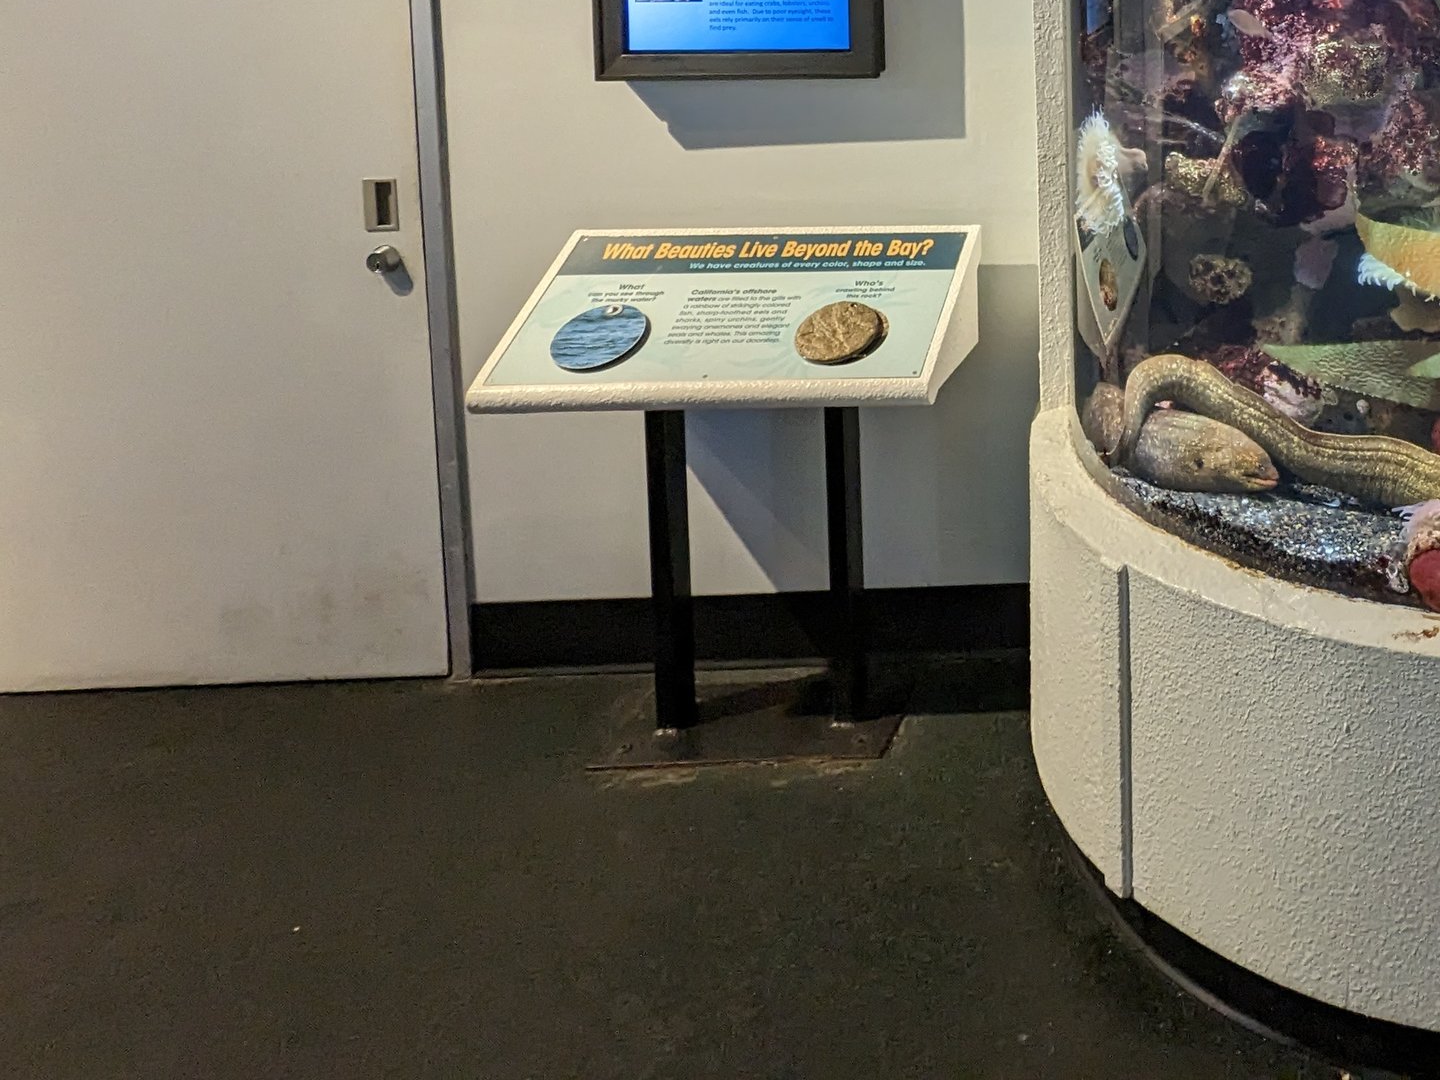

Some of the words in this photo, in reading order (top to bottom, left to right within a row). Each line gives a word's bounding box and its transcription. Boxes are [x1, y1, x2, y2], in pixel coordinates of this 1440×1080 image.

[603, 243, 654, 260] What
[654, 242, 736, 259] Beauties
[738, 241, 778, 258] Live
[781, 240, 852, 260] Beyond
[853, 240, 883, 256] the
[887, 239, 934, 259] Bay?
[852, 260, 882, 268] shape
